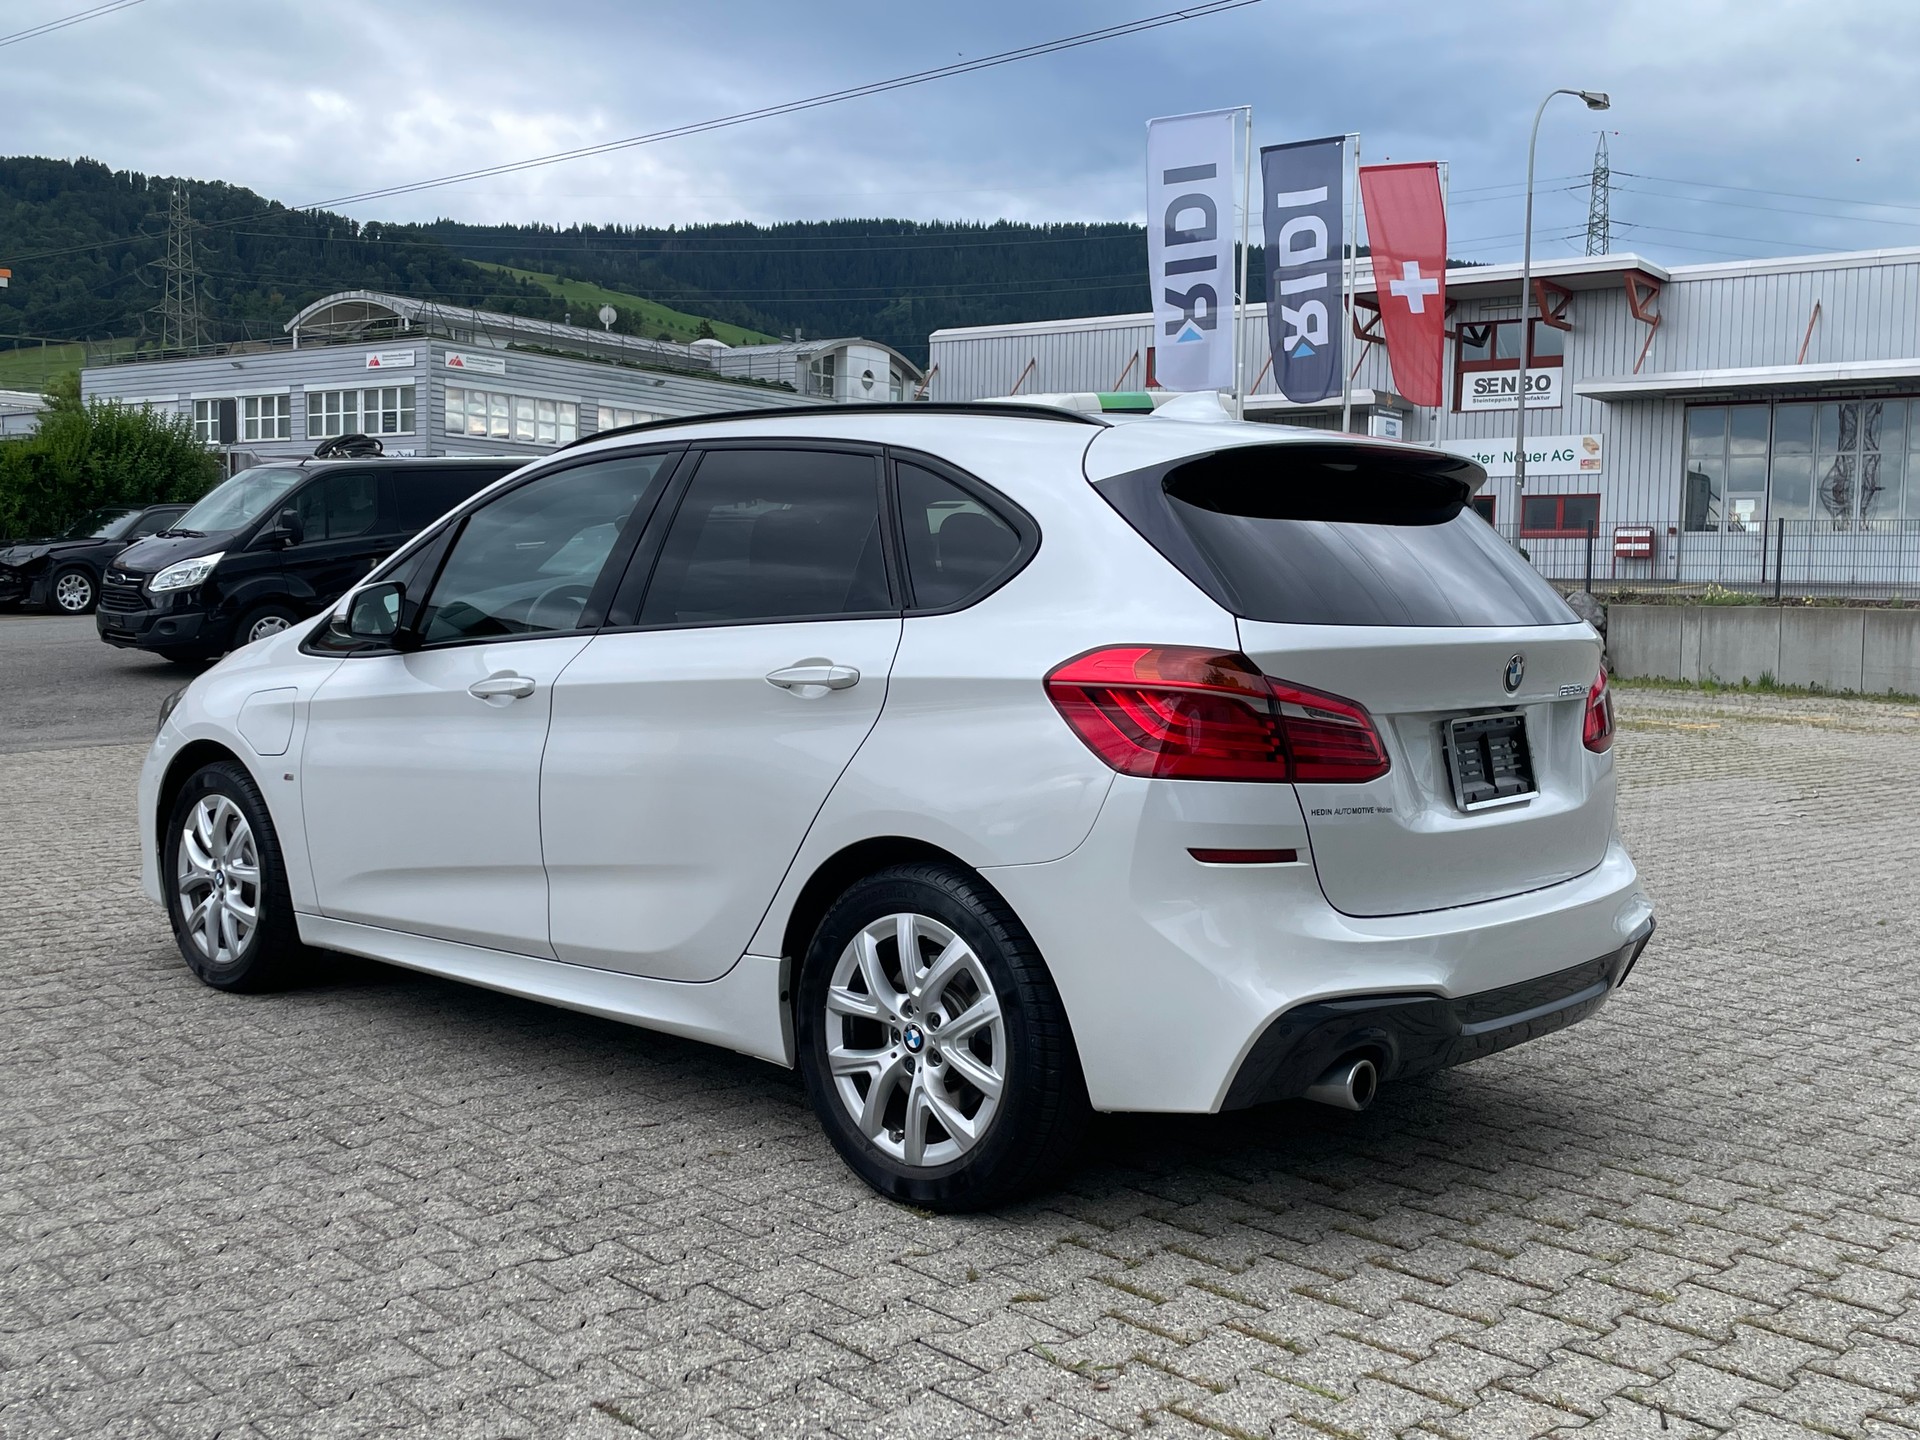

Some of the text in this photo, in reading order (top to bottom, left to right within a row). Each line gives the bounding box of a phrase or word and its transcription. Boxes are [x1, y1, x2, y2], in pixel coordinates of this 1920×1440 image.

[1472, 396, 1512, 404] Steinteppich
[1503, 450, 1547, 463] Nuer
[1551, 449, 1574, 461] AG
[1311, 808, 1333, 816] HEDIN
[1334, 807, 1374, 815] AUTOMOTIVE
